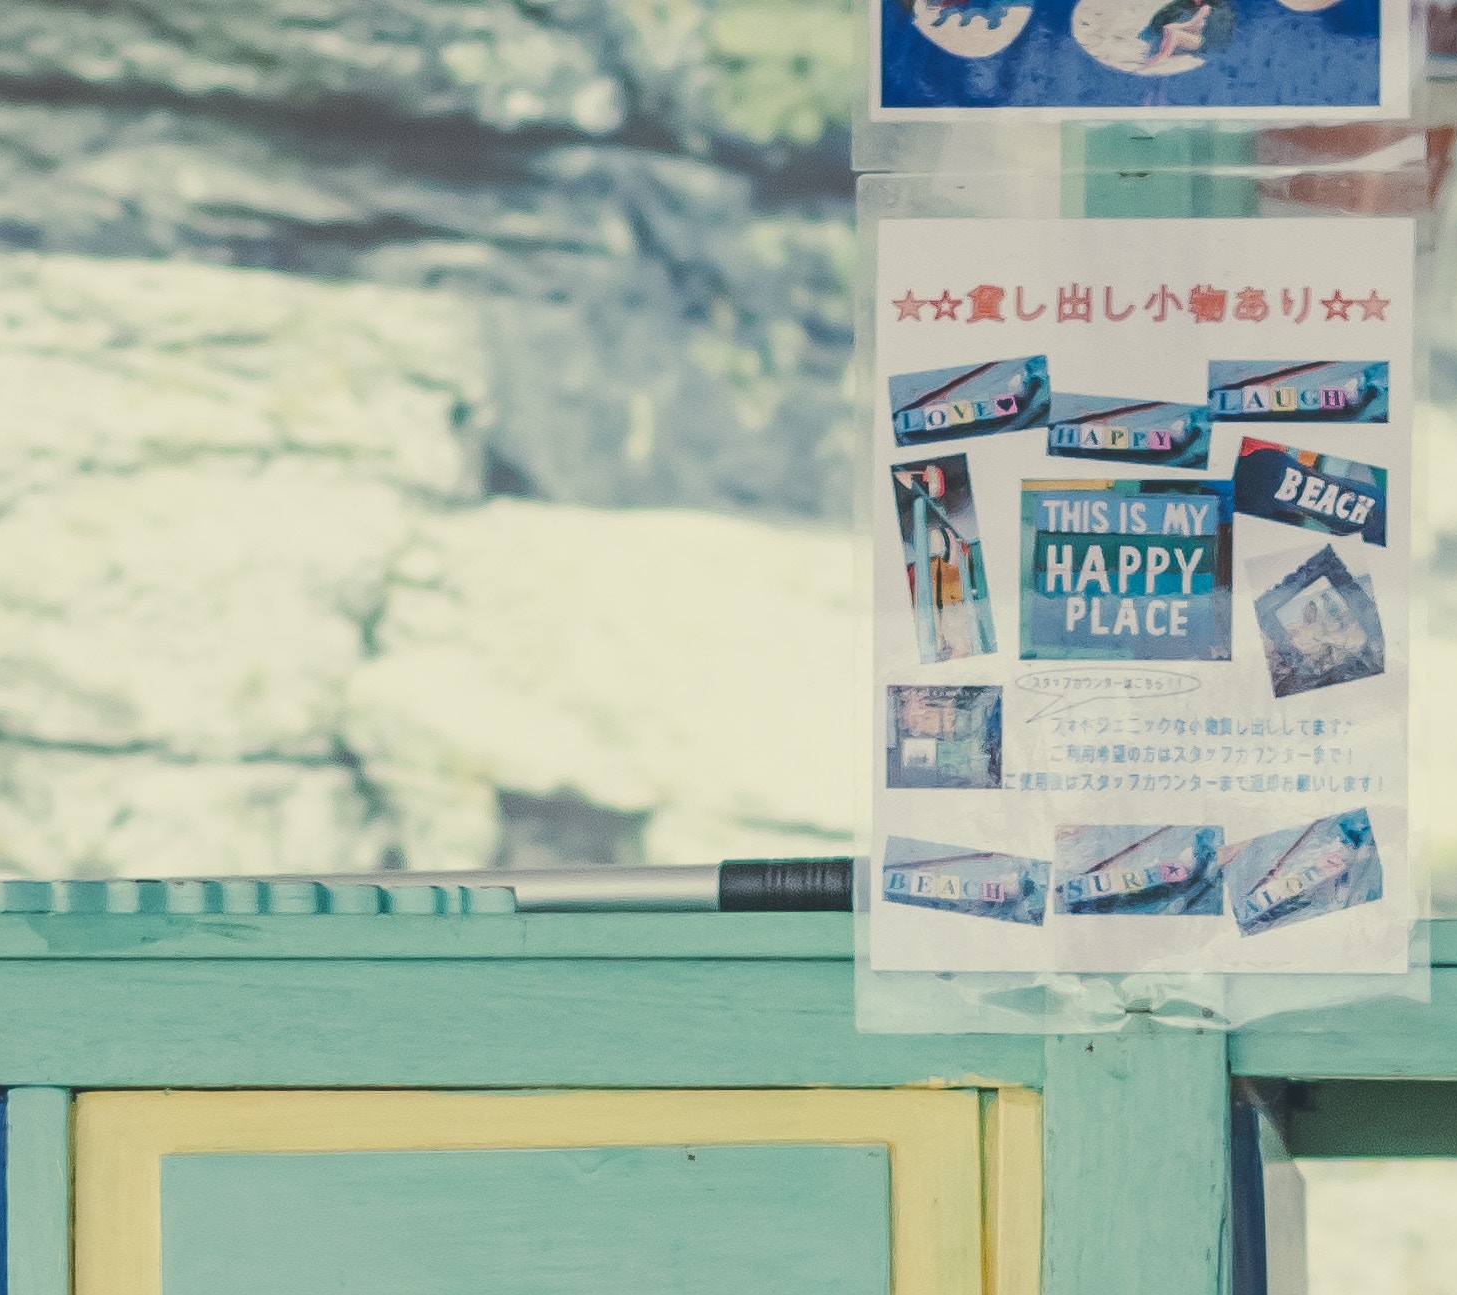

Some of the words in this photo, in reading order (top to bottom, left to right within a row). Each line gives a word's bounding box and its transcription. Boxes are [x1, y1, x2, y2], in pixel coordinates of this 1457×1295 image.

[1218, 389, 1341, 411] LAUGH
[901, 402, 990, 431] LOVE
[1056, 427, 1168, 447] HAPPY
[1274, 466, 1376, 525] BEACH
[1043, 500, 1111, 534] THIS
[1119, 501, 1147, 534] IS
[1163, 502, 1209, 536] MY
[1046, 544, 1204, 595] HAPPY
[1065, 597, 1189, 637] PLACE
[889, 873, 1000, 900] BEACH
